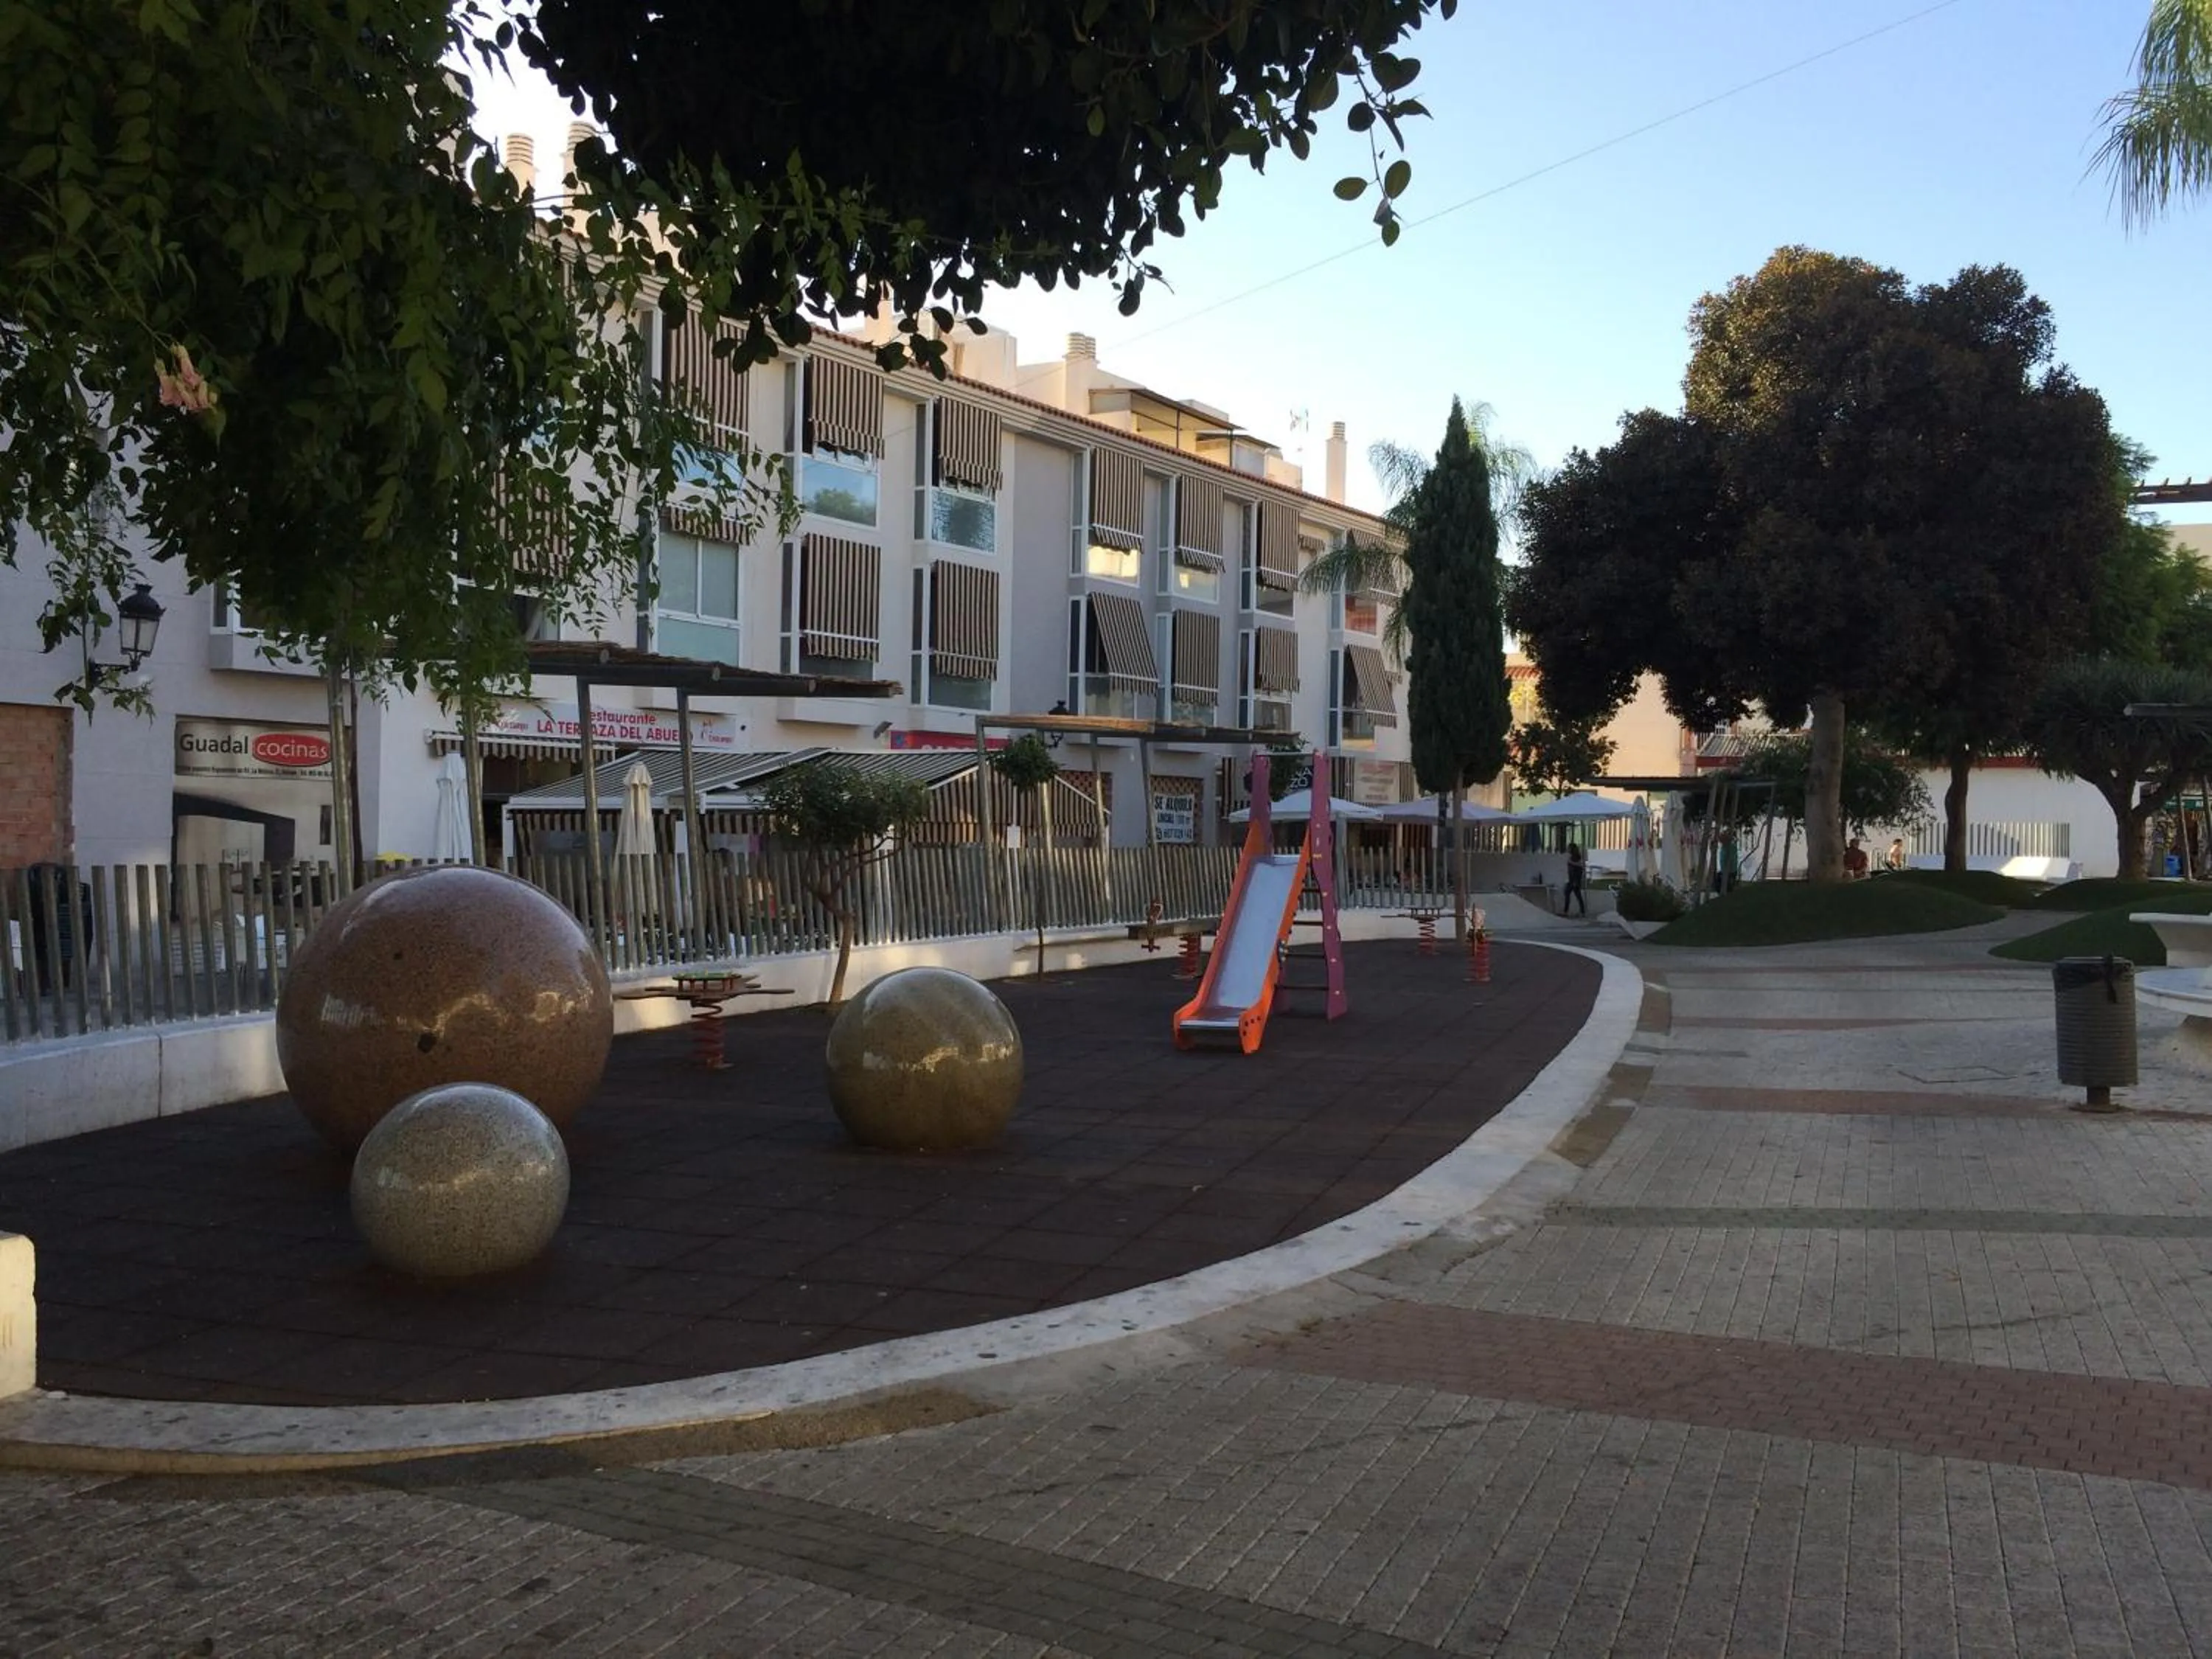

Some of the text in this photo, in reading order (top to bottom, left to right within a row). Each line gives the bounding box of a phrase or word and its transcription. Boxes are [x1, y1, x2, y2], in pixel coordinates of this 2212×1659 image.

[589, 709, 656, 725] estaurante
[538, 720, 553, 733] LA
[557, 721, 616, 737] TERAZA
[620, 726, 641, 740] DEL
[646, 726, 693, 742] ABUE
[180, 734, 328, 758] Guadal cocinas
[1155, 796, 1164, 810] SE
